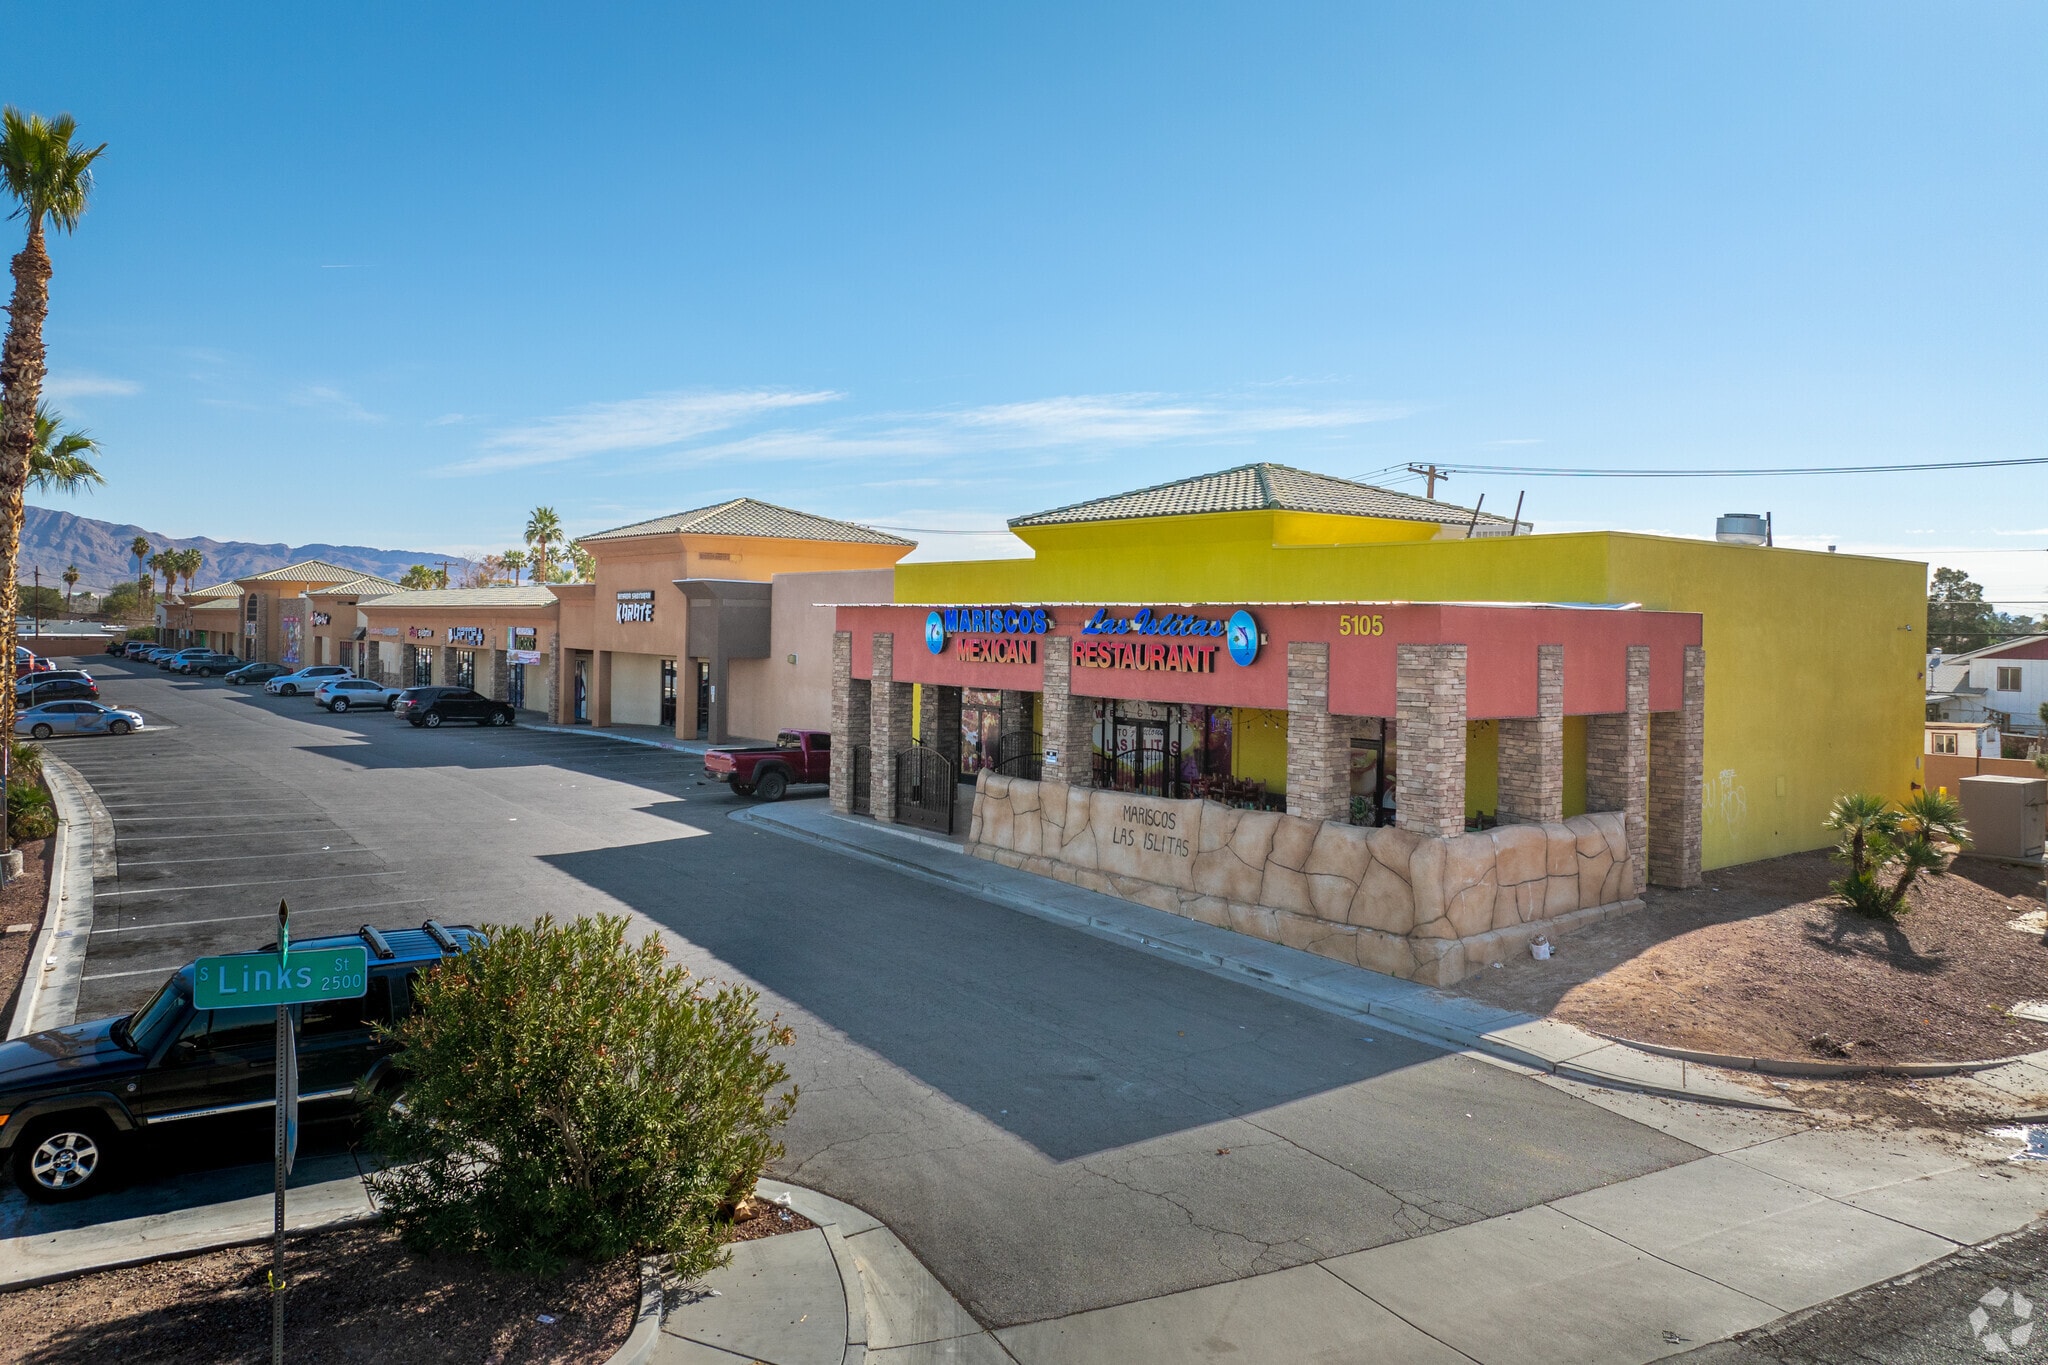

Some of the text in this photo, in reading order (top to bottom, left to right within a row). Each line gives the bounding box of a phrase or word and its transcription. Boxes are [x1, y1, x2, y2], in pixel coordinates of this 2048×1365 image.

[616, 603, 653, 624] KARATE
[944, 608, 1225, 637] MARISCOS Las Islitas
[453, 627, 477, 641] LAPTOP
[1339, 614, 1384, 636] 5105
[957, 639, 1215, 673] MEXICAN RESTAURANT
[1117, 729, 1128, 737] TO
[1131, 738, 1180, 754] ILITS
[1123, 805, 1176, 830] MARISCOS
[1113, 826, 1189, 857] LAS ISLITAS
[199, 957, 350, 994] S Links St
[321, 974, 361, 991] 2500
